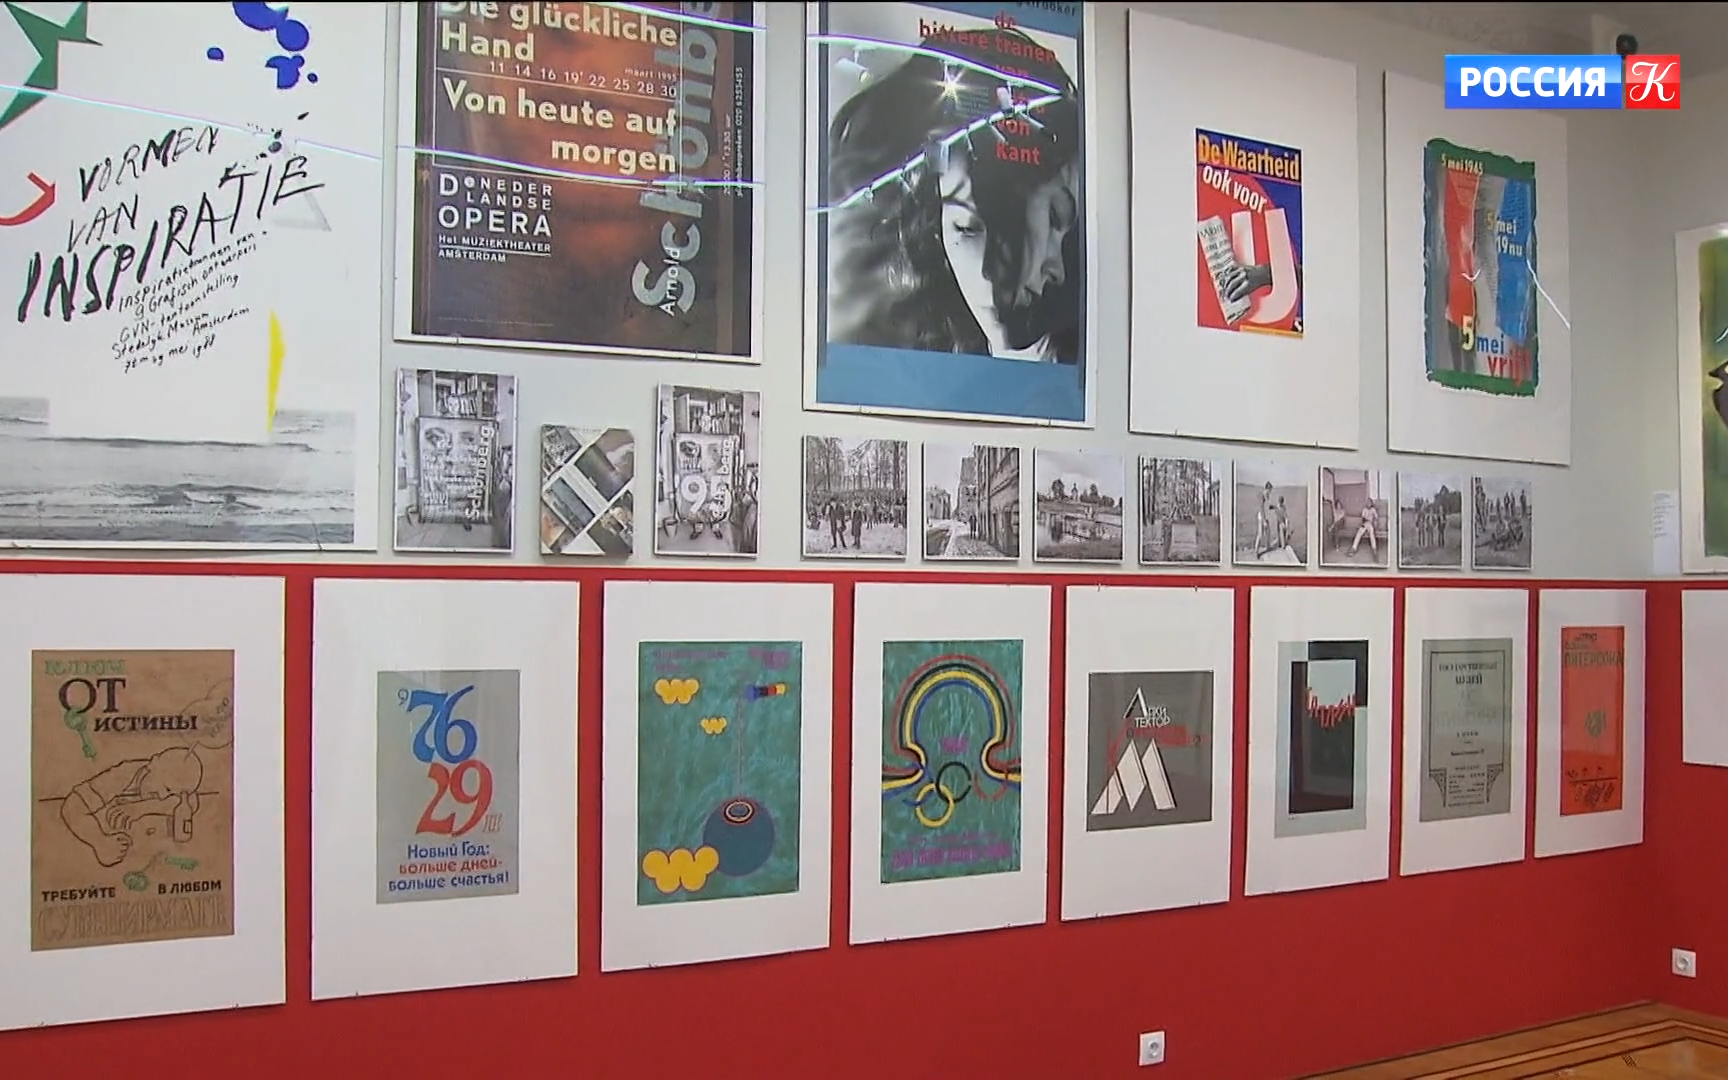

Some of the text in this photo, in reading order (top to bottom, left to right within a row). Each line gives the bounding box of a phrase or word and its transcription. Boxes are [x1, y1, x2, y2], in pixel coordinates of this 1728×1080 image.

[442, 20, 535, 62] Hand
[920, 19, 1056, 64] bittere tranen
[490, 61, 504, 73] 11
[515, 64, 531, 77] 14
[541, 68, 556, 80] 16
[589, 75, 606, 88] 22
[614, 78, 630, 91] 25
[637, 81, 654, 95] 28
[661, 85, 677, 98] 30
[443, 78, 677, 138] Von heute auf
[79, 126, 219, 202] VORMEN
[552, 140, 677, 175] morgen
[1198, 134, 1299, 180] De Waarheid
[466, 191, 551, 211] LANDSE
[481, 177, 552, 197] NEDER
[1203, 165, 1268, 213] ook voor
[17, 155, 326, 323] INSPIRATIE
[67, 194, 138, 252] VAN
[438, 205, 552, 237] OPERA
[1496, 219, 1518, 236] mei
[438, 234, 551, 252] Het MUZIEKTHEATER
[438, 249, 506, 262] AMSTERDAM
[660, 248, 681, 316] Arnold
[1462, 315, 1504, 355] 5 mei
[58, 677, 126, 714] ОТ
[94, 714, 198, 732] ИСТИНЫ
[415, 759, 493, 838] 29
[408, 841, 490, 859] Новый Год:
[42, 879, 222, 902] ТРЕБУЙТЕ В ЛЮБОМ
